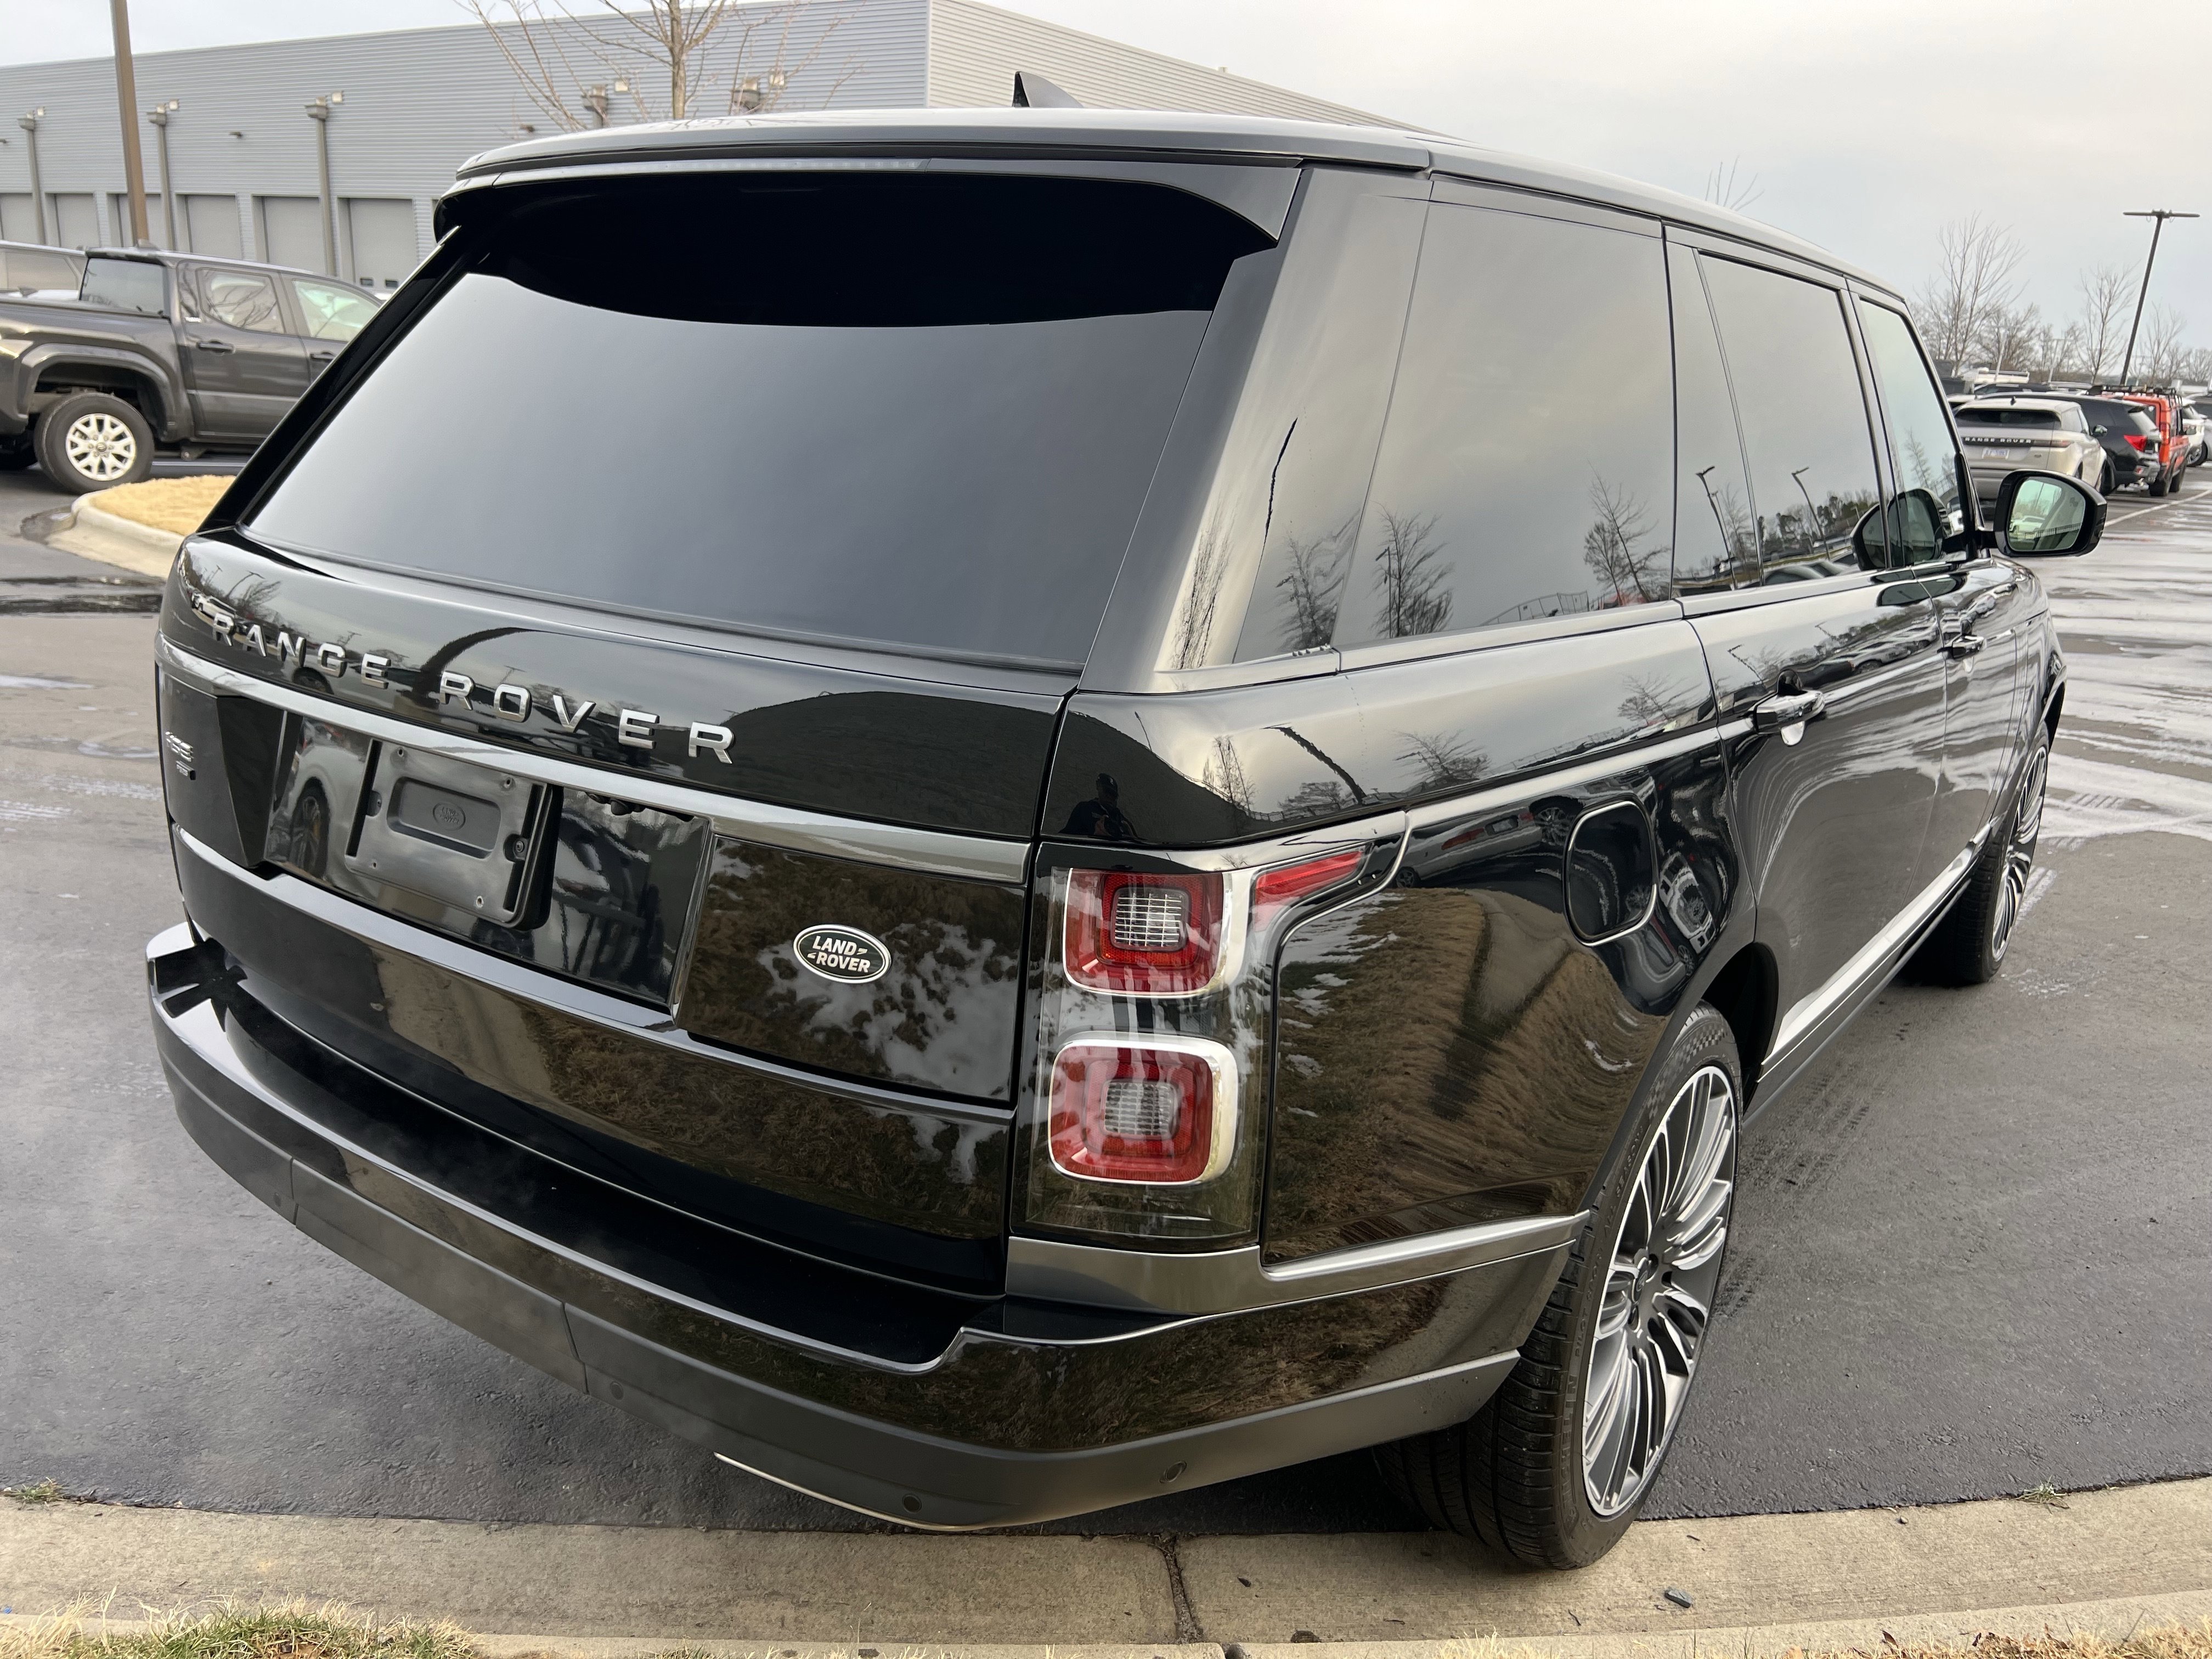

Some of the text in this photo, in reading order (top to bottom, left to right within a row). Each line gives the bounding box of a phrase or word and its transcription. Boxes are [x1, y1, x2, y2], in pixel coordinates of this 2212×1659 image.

[212, 612, 736, 766] RANGE ROVER
[812, 935, 857, 956] LAND
[815, 951, 871, 973] ROVER
[1575, 1307, 1587, 1358] PILOT
